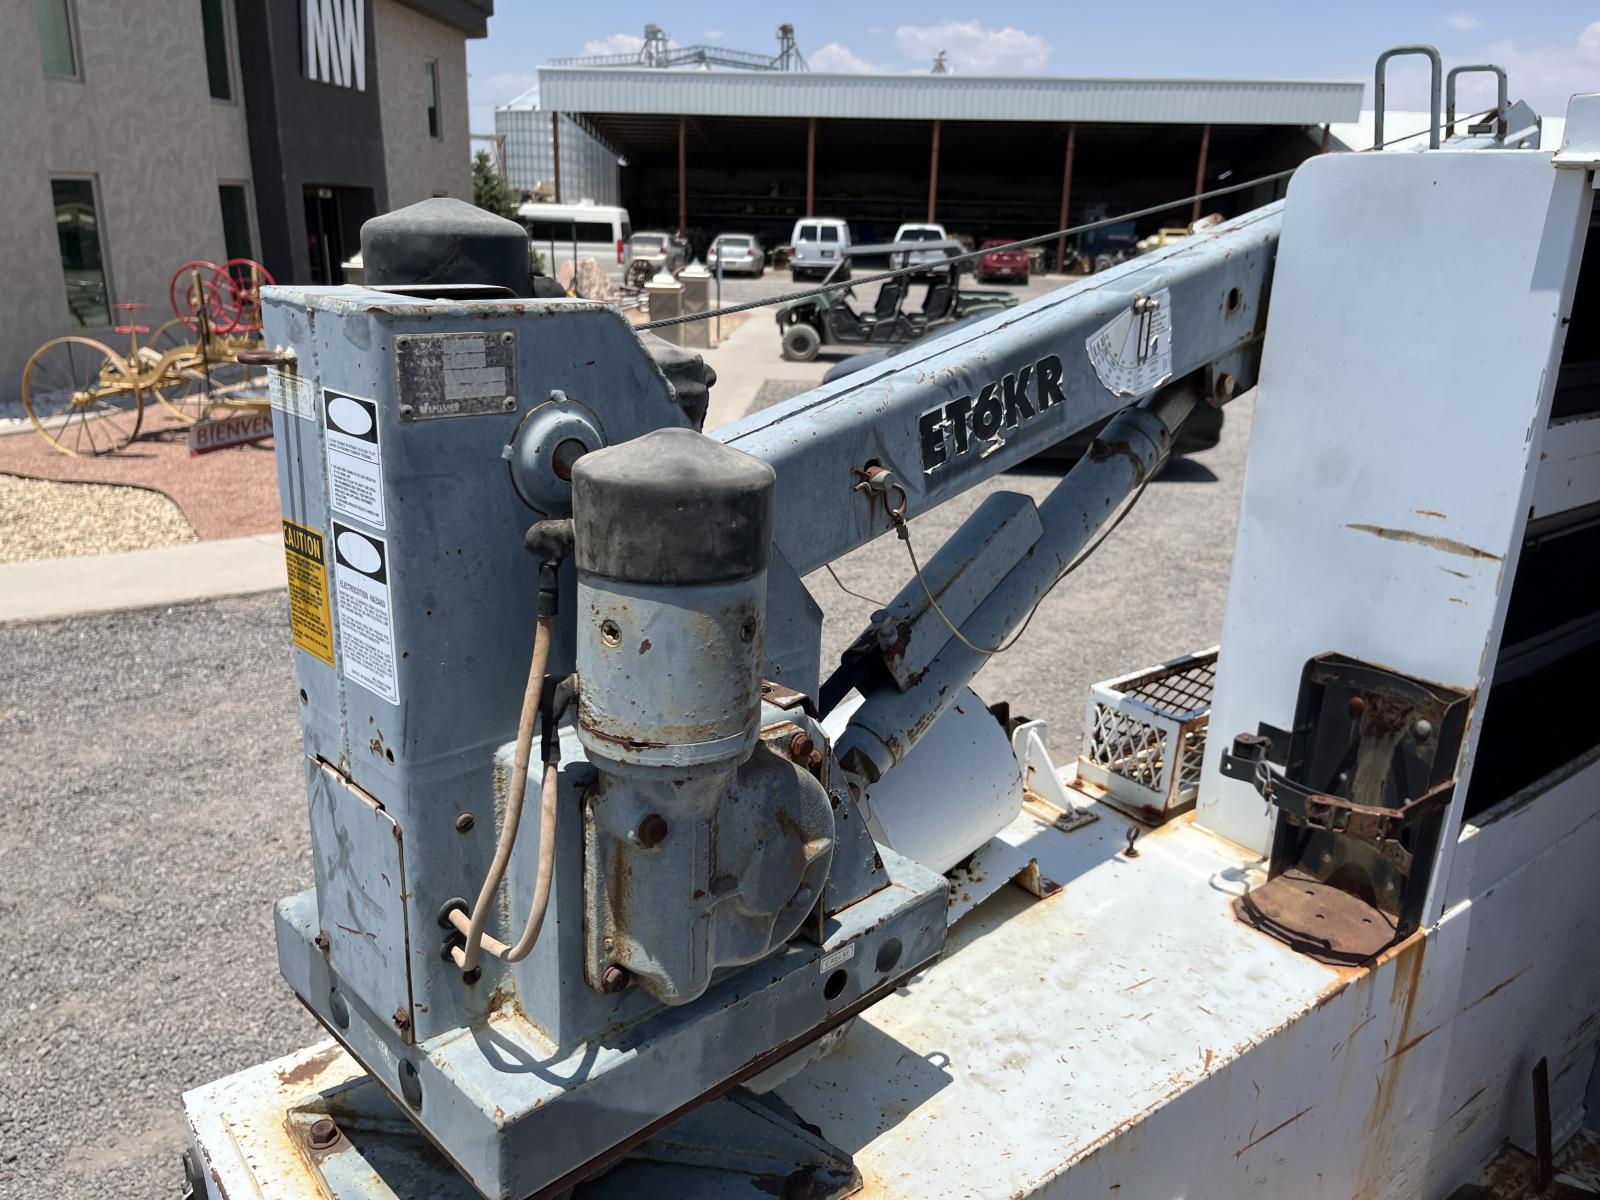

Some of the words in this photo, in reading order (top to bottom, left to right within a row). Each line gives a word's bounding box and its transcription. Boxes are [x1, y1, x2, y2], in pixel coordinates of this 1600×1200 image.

[919, 354, 1067, 473] ET6KR
[283, 524, 321, 560] CAUTION
[339, 579, 369, 600] ELECTROCUTION
[369, 594, 386, 608] HAZARD
